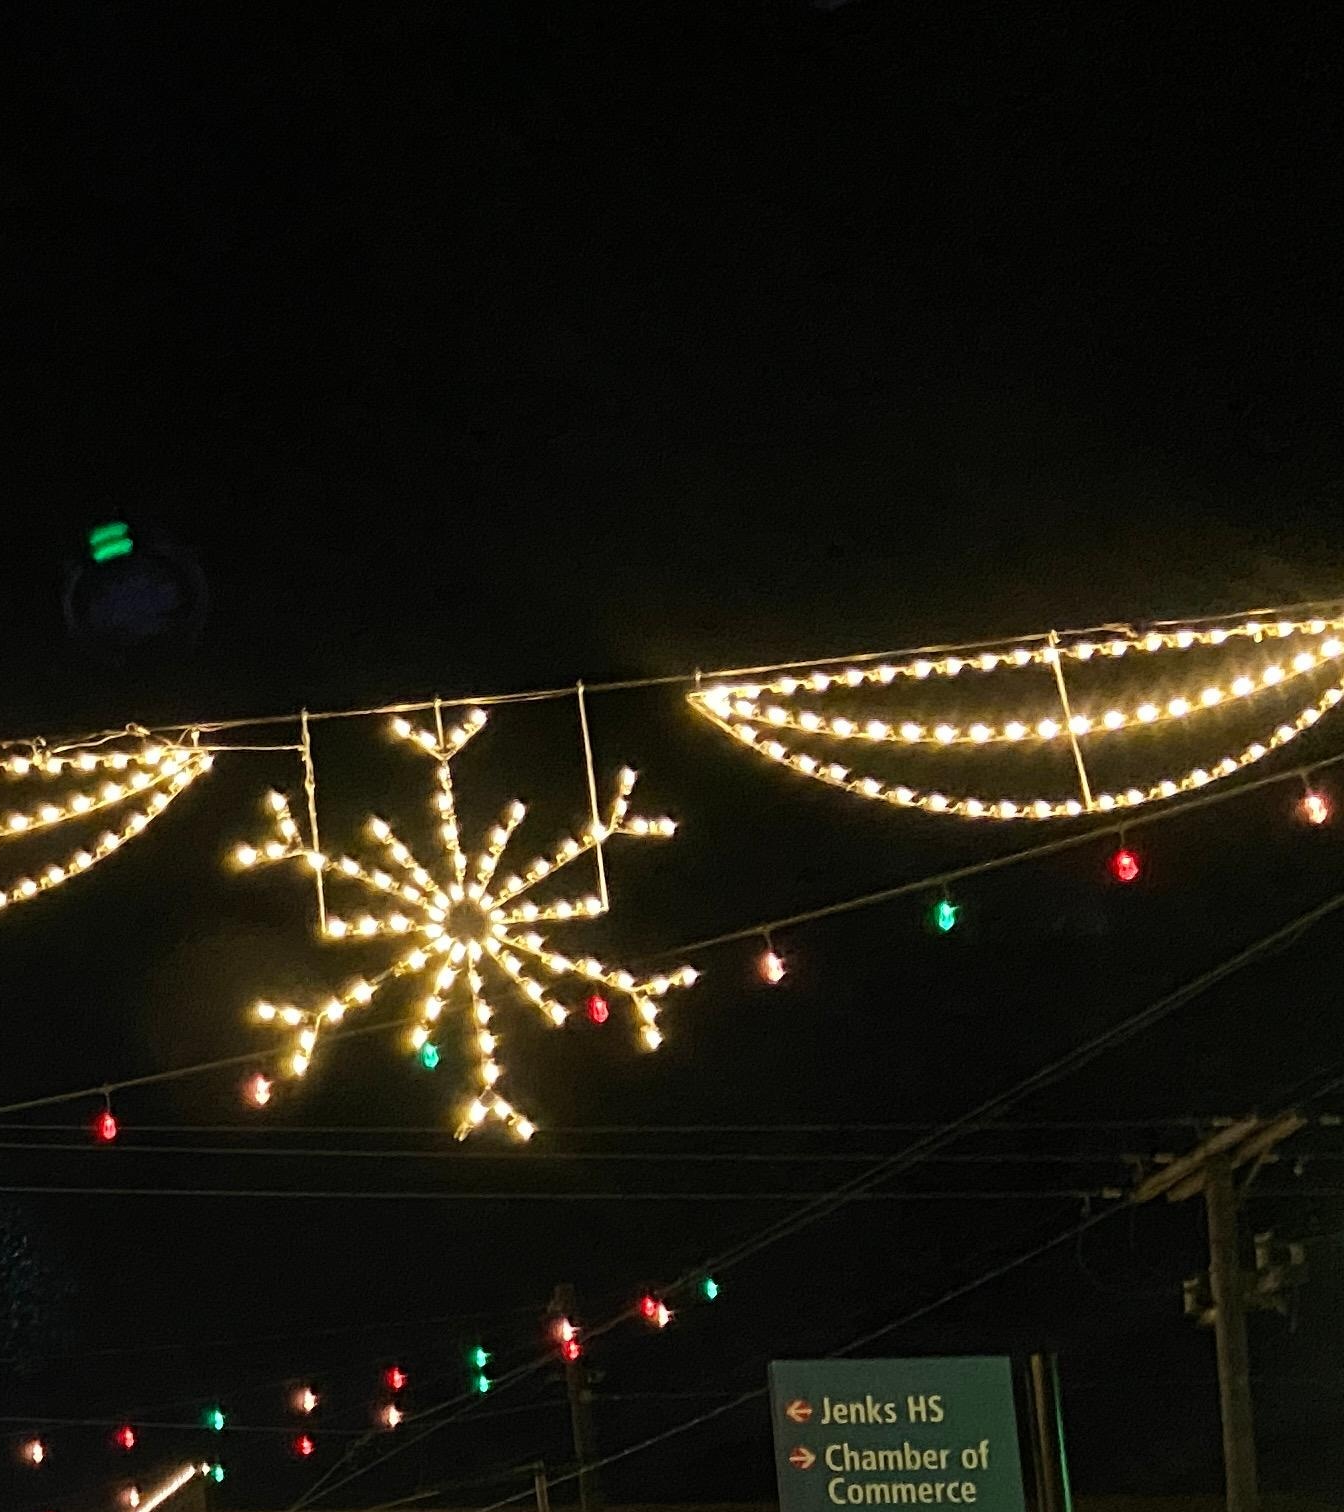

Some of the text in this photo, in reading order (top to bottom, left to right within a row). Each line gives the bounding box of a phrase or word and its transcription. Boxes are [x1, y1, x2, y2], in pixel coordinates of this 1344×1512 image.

[821, 1395, 944, 1424] Jenks HS
[825, 1439, 989, 1471] Chamber of
[828, 1477, 977, 1504] Commerce
